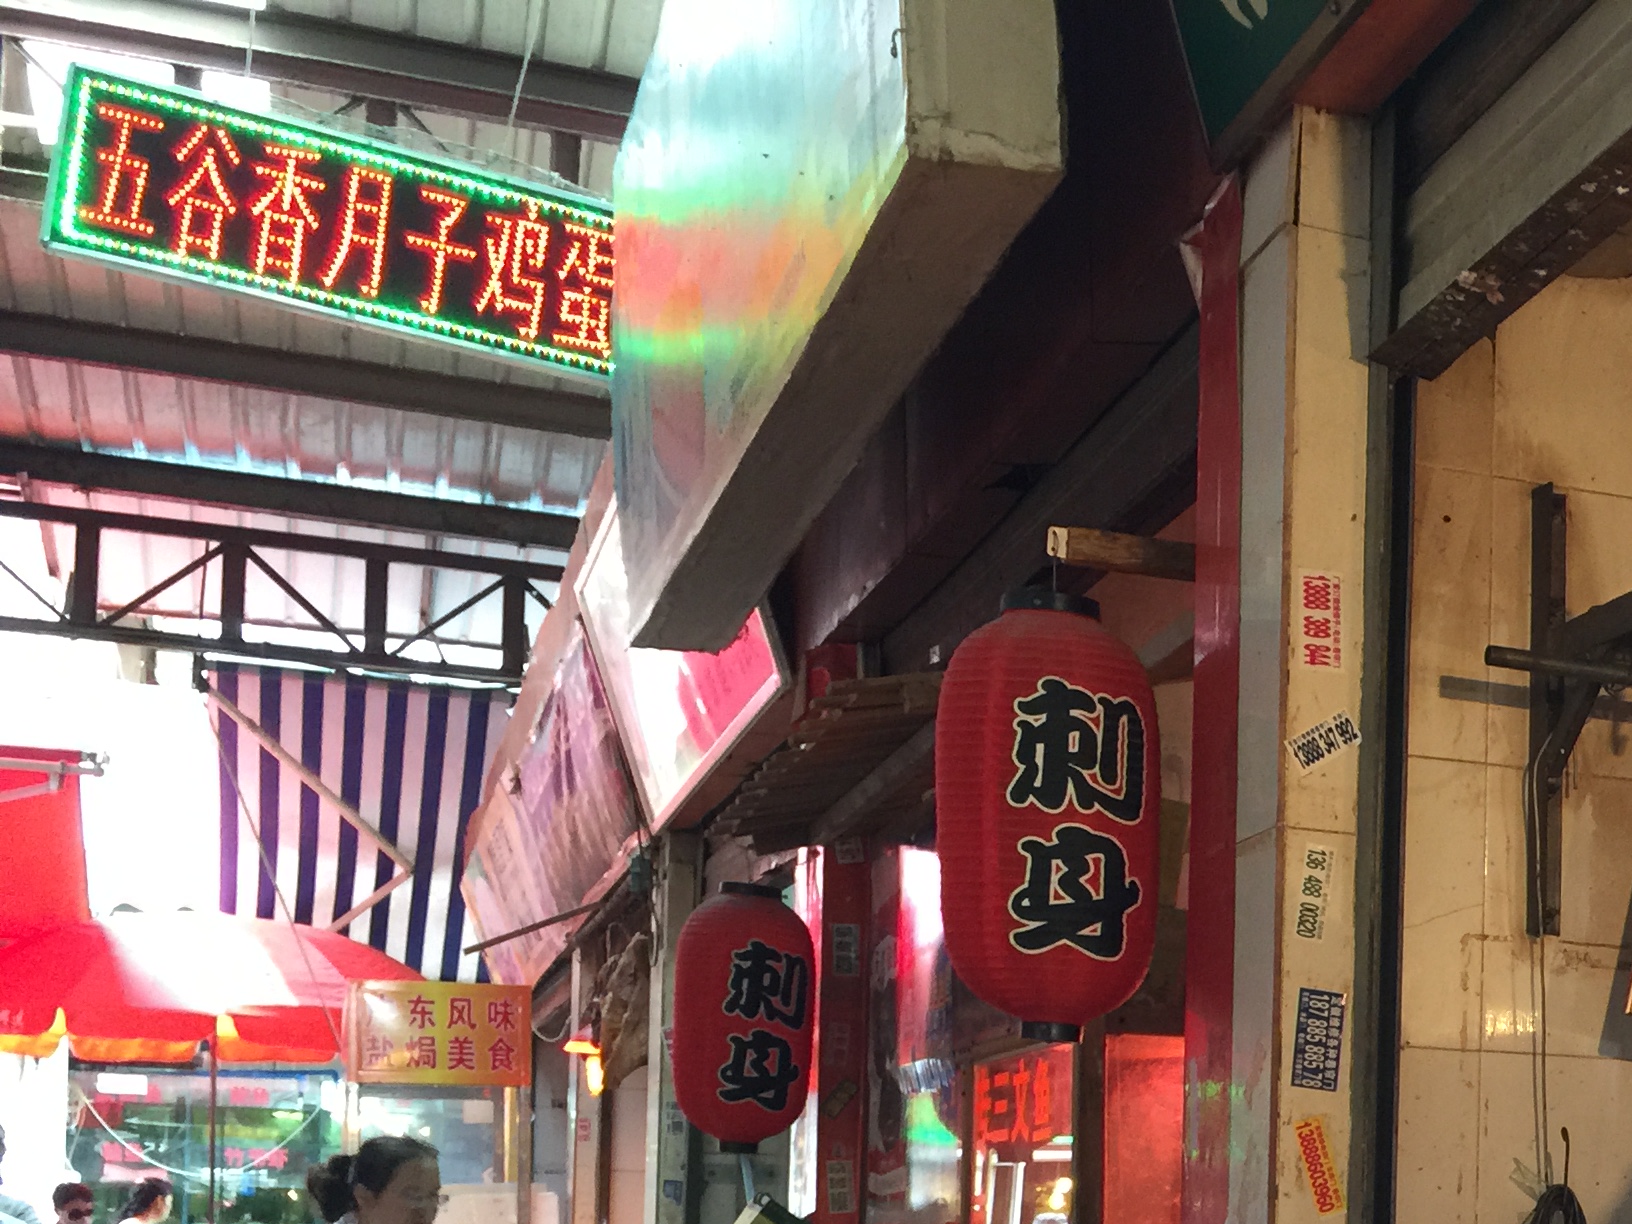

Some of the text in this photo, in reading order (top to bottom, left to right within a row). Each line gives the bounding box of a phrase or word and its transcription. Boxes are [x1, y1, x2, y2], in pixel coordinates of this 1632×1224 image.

[79, 102, 616, 359] 五谷香月子鸡蛋
[1303, 575, 1331, 666] 13888 389 844
[1292, 736, 1325, 769] 13888
[1317, 726, 1341, 755] 347
[1005, 677, 1145, 962] 刺身
[1305, 850, 1328, 872] 136
[1302, 874, 1324, 898] 488
[1296, 901, 1319, 939] 00320
[1307, 994, 1331, 1017] 187
[716, 939, 809, 1112] 刺身
[1305, 1018, 1328, 1043] 885
[1303, 1044, 1325, 1069] 885
[1301, 1072, 1323, 1088] 78
[1295, 1121, 1335, 1214] 13888603960
